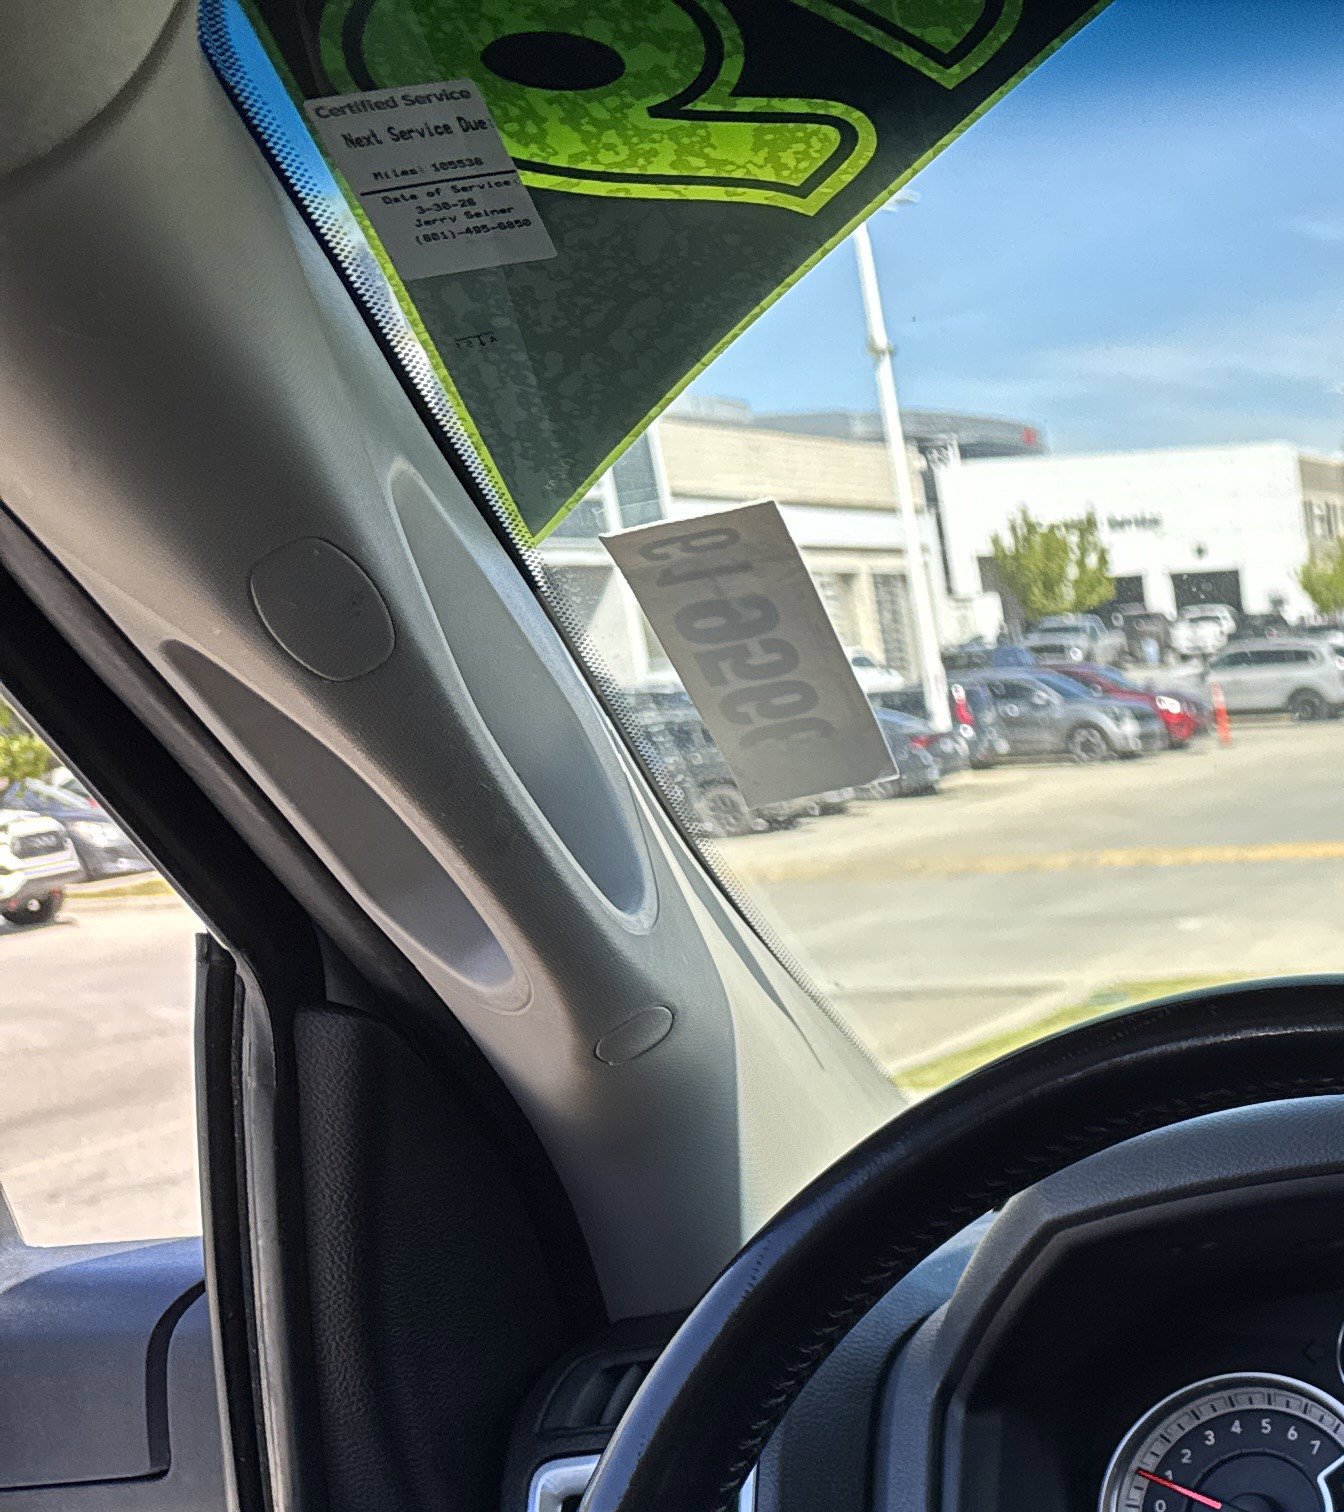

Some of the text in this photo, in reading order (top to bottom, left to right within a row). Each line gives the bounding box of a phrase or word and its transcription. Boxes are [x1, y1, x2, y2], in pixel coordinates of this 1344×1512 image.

[314, 88, 472, 120] Certified Service
[341, 130, 382, 149] Next
[386, 122, 453, 143] Service
[381, 192, 418, 205] Date
[427, 188, 441, 198] of
[1231, 1419, 1242, 1435] 4
[1261, 1418, 1272, 1434] 5
[1287, 1425, 1299, 1441] 6
[1205, 1430, 1216, 1447] 3
[1309, 1440, 1322, 1455] 7
[1181, 1449, 1193, 1464] 2
